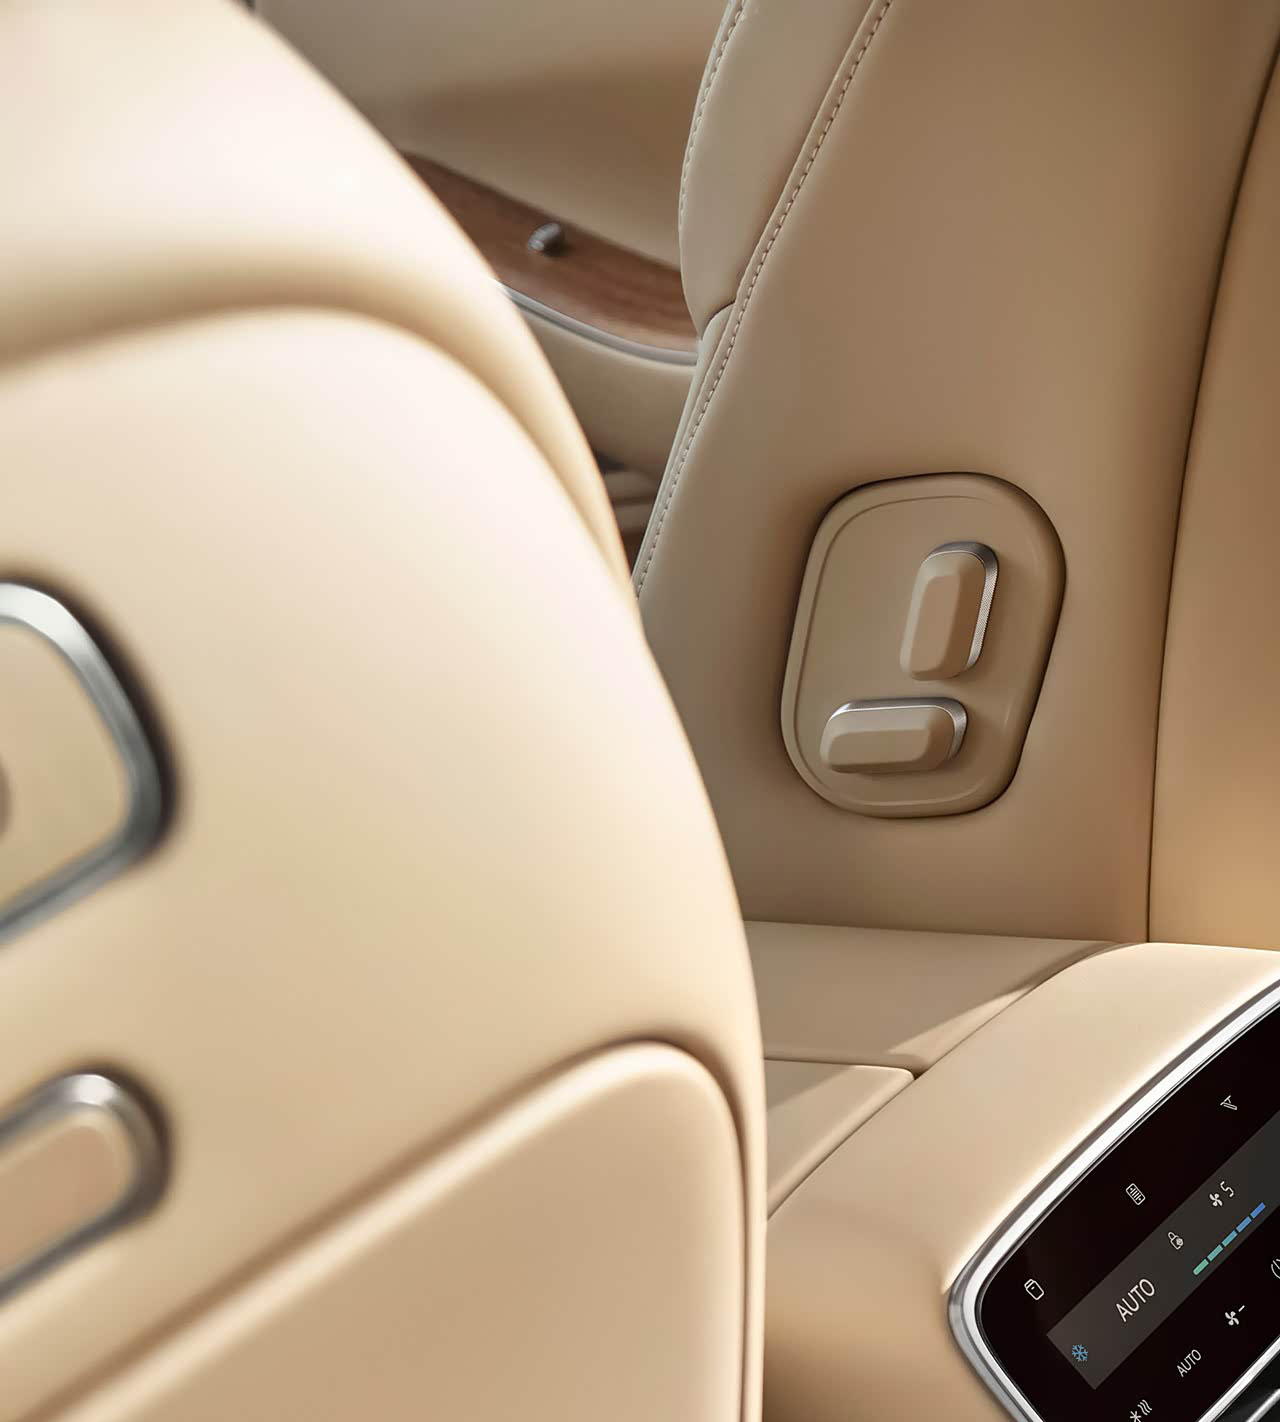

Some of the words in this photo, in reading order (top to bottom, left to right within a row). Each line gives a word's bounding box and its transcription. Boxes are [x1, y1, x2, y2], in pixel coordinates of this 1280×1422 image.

[1219, 1180, 1235, 1198] 5
[1115, 1278, 1155, 1323] AUTO
[1176, 1349, 1202, 1378] AUTO
